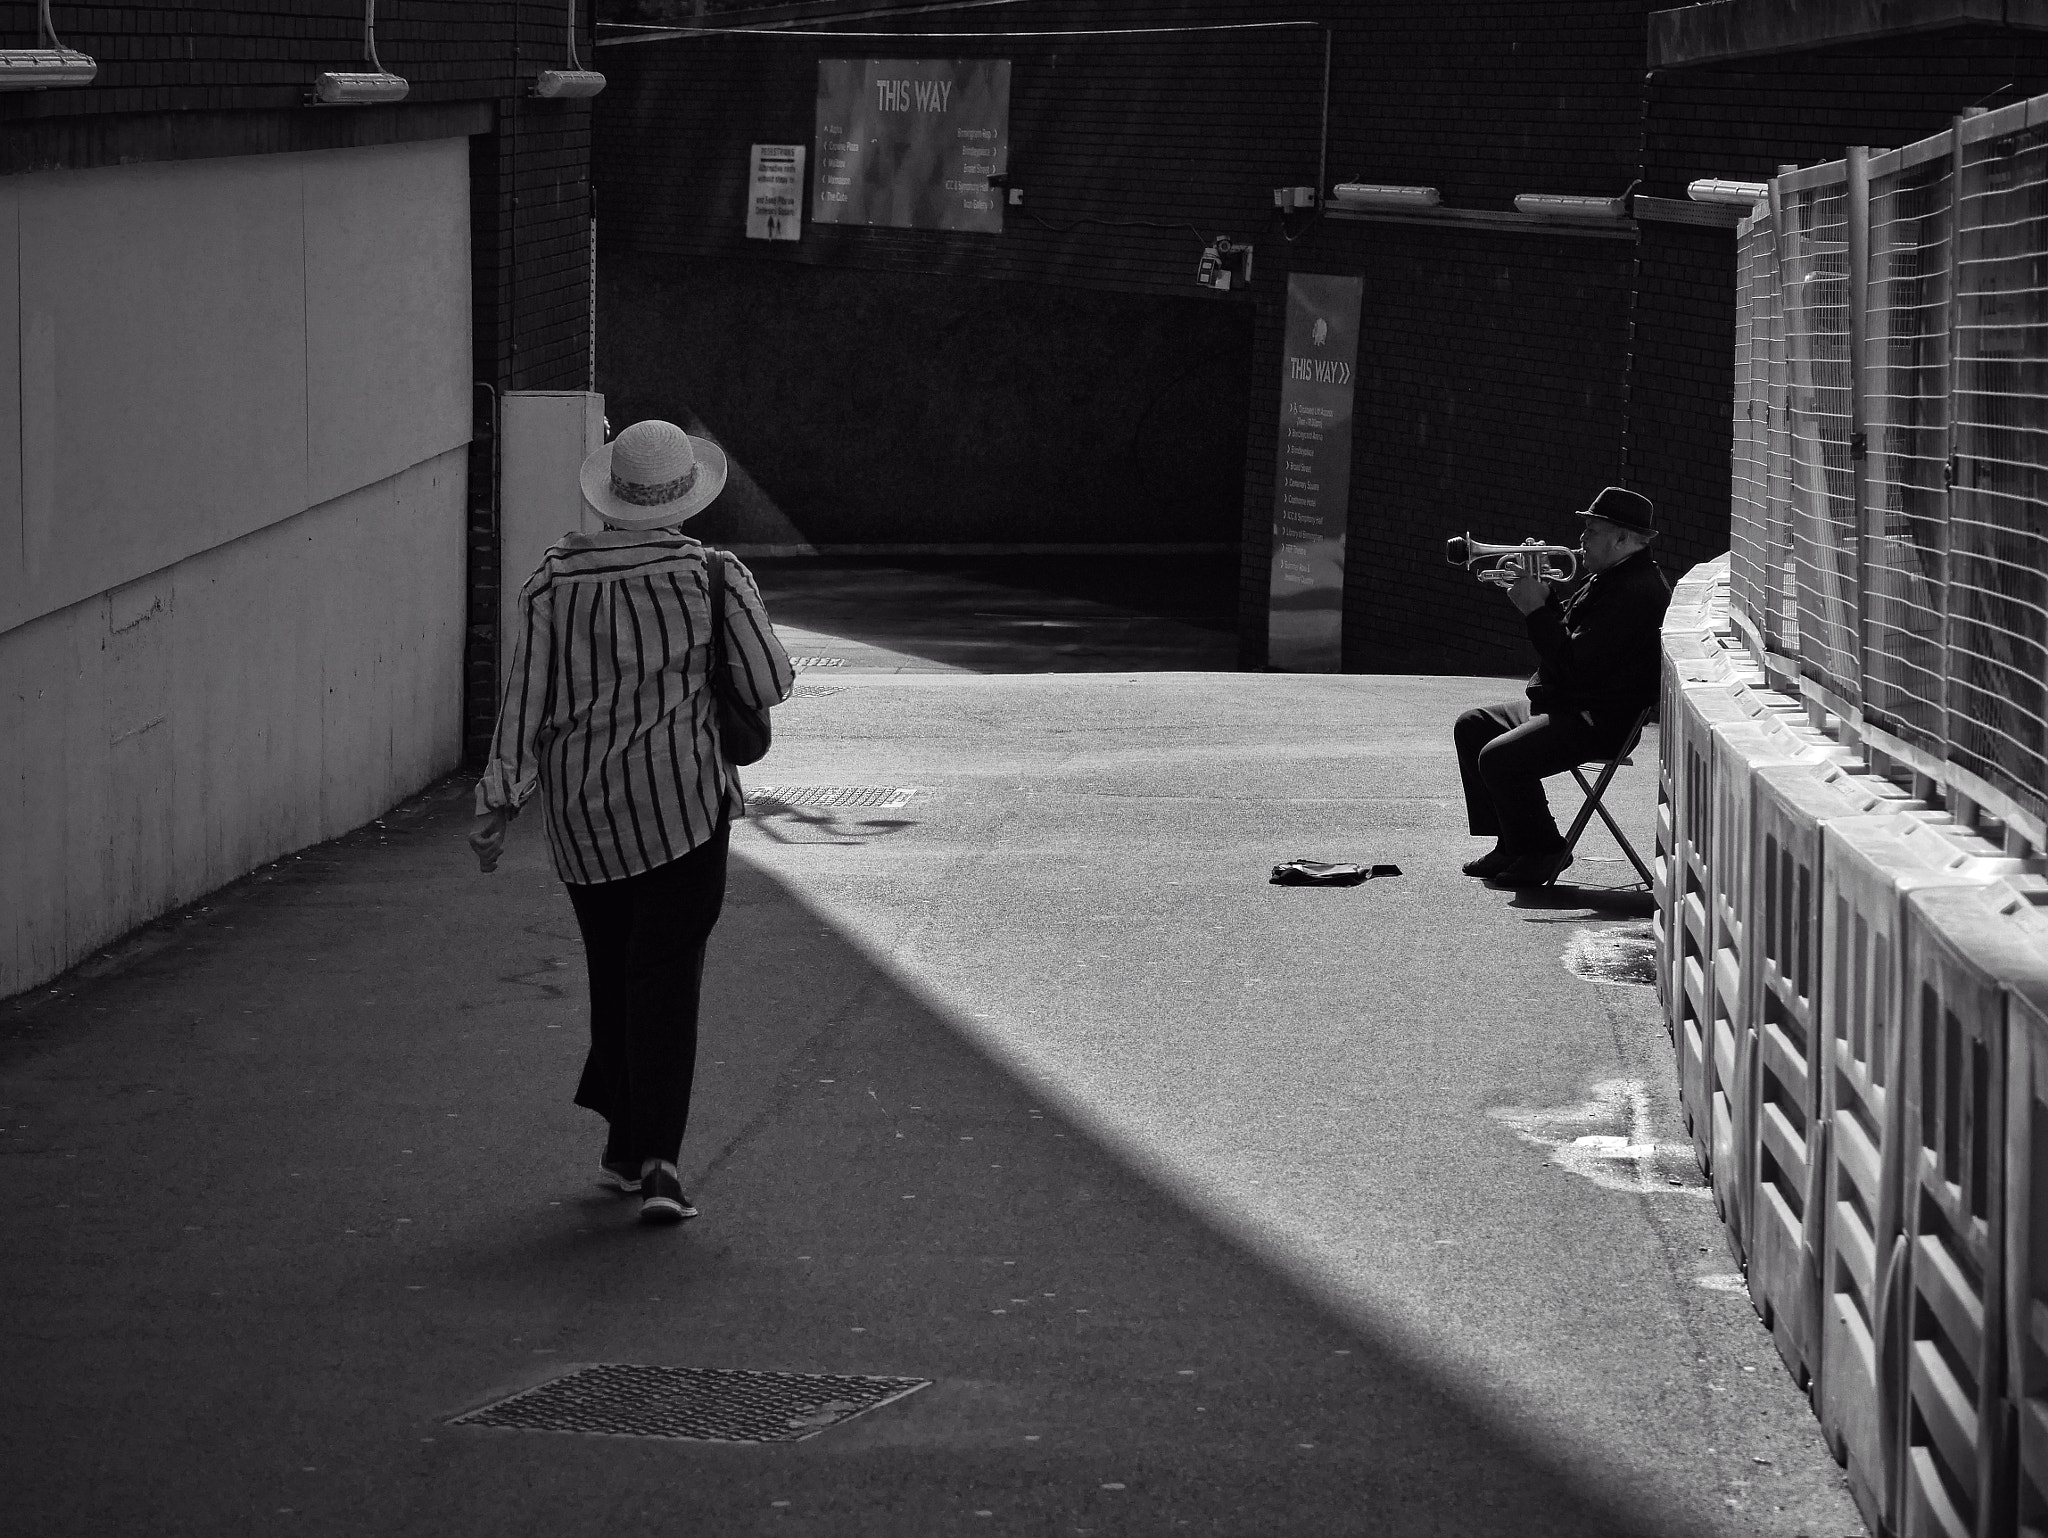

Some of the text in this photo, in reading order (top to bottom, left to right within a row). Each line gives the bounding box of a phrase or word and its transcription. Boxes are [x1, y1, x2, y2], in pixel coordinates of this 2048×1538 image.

[876, 79, 952, 113] THIS WAY
[1290, 356, 1338, 384] THIS WAY
